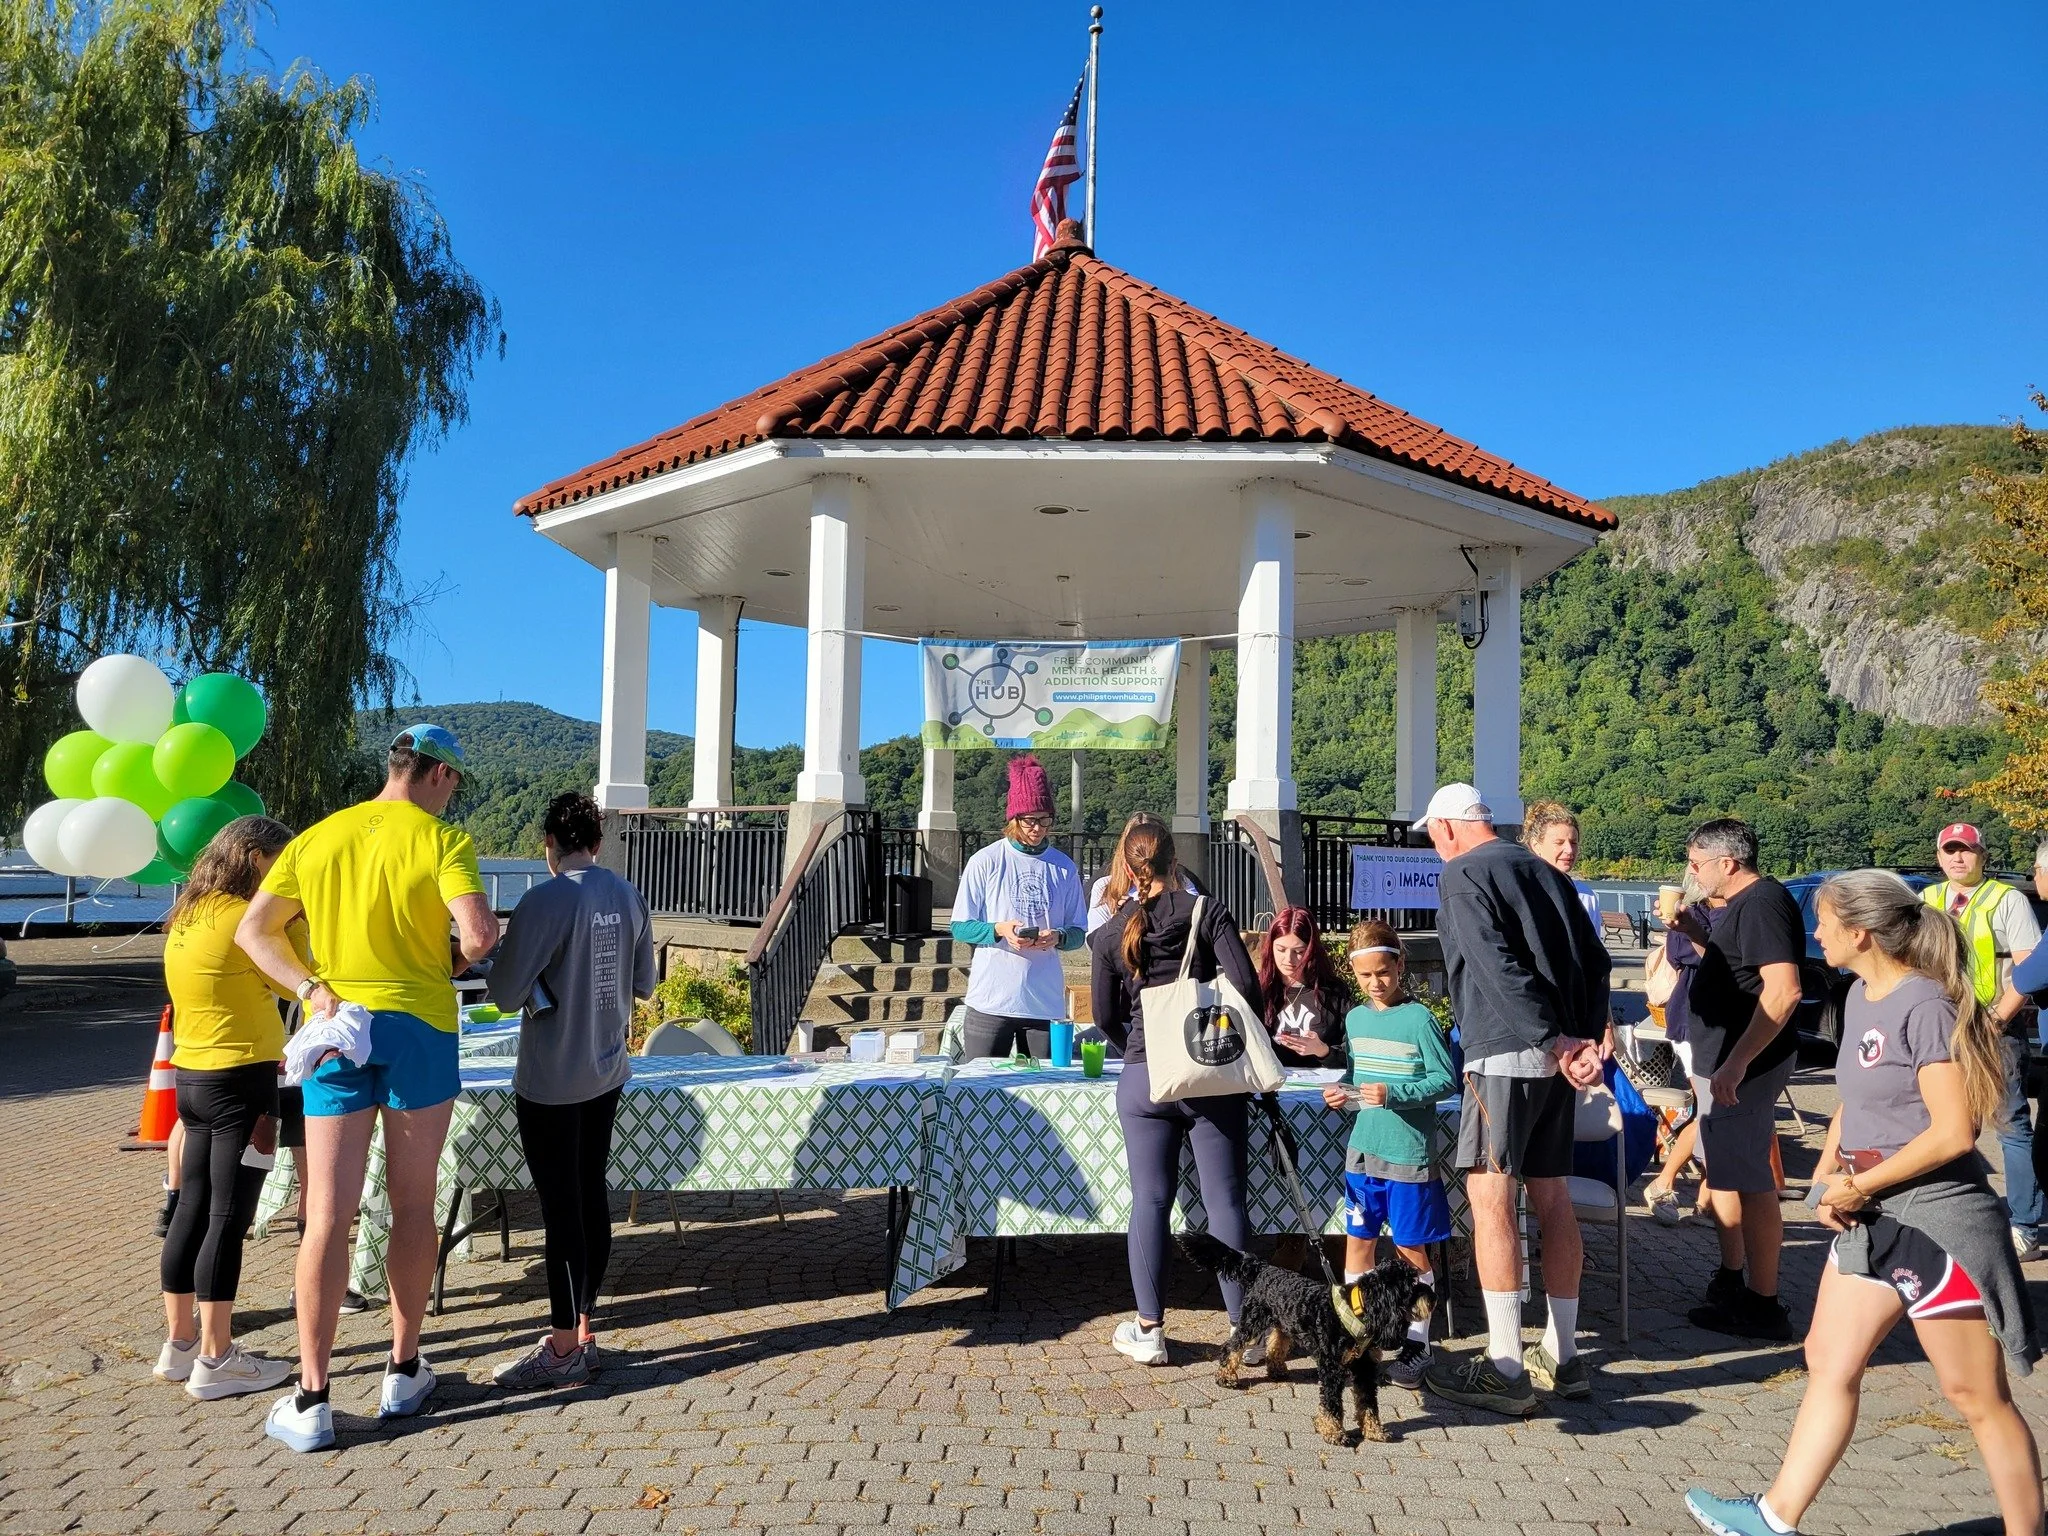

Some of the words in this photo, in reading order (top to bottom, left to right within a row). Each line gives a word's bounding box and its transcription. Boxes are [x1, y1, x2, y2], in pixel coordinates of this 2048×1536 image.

[1053, 657, 1082, 665] FREE
[1085, 656, 1156, 666] COMMUNITY
[1052, 666, 1099, 675] MENTAL
[1102, 666, 1147, 675] HEALTH
[1150, 666, 1157, 675] &
[1044, 677, 1108, 686] ADDICTION
[1111, 677, 1164, 686] SUPPORT
[976, 686, 1020, 699] HUB
[1055, 693, 1153, 701] www.philipstownhub.org
[1356, 854, 1374, 862] THANK
[1399, 872, 1440, 887] IMPACT
